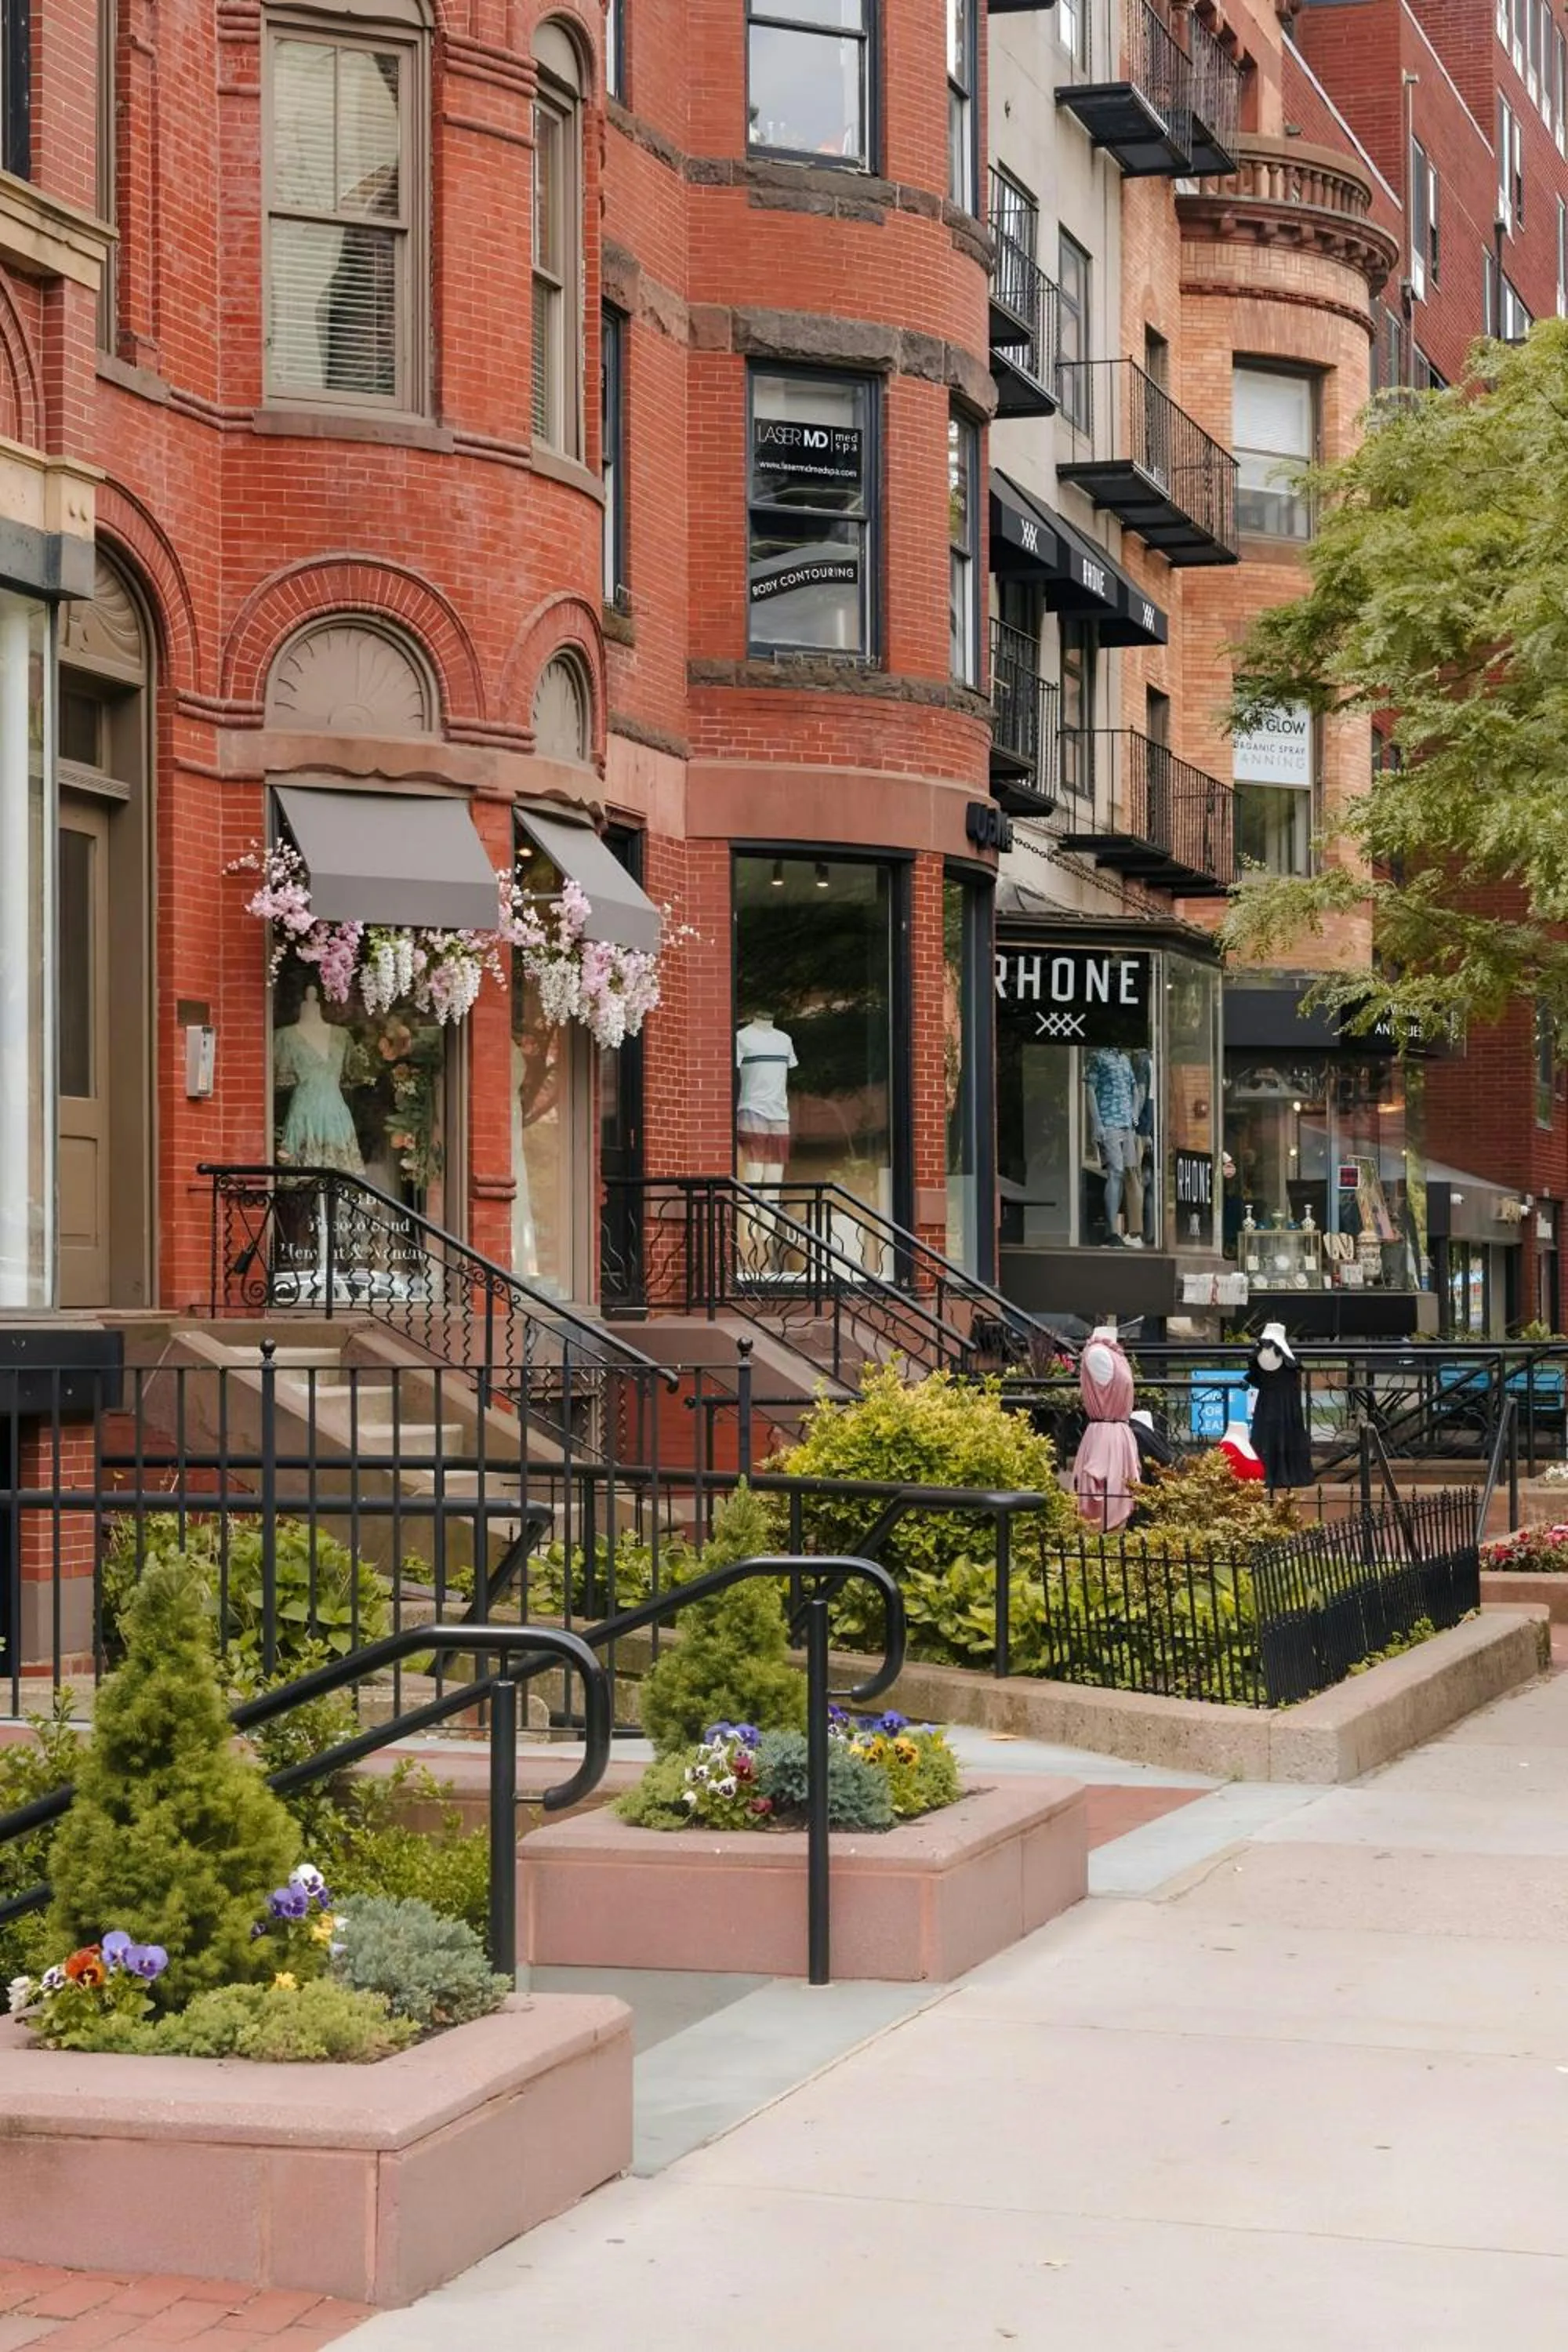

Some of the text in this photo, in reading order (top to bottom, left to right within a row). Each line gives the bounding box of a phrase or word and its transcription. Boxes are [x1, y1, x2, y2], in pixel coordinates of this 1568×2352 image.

[757, 425, 829, 448] LASER MD
[834, 432, 858, 443] med
[834, 441, 858, 455] spa
[752, 567, 854, 597] BODY CONTOURING
[994, 953, 1140, 1005] RHONE
[1178, 1157, 1211, 1204] RHONE
